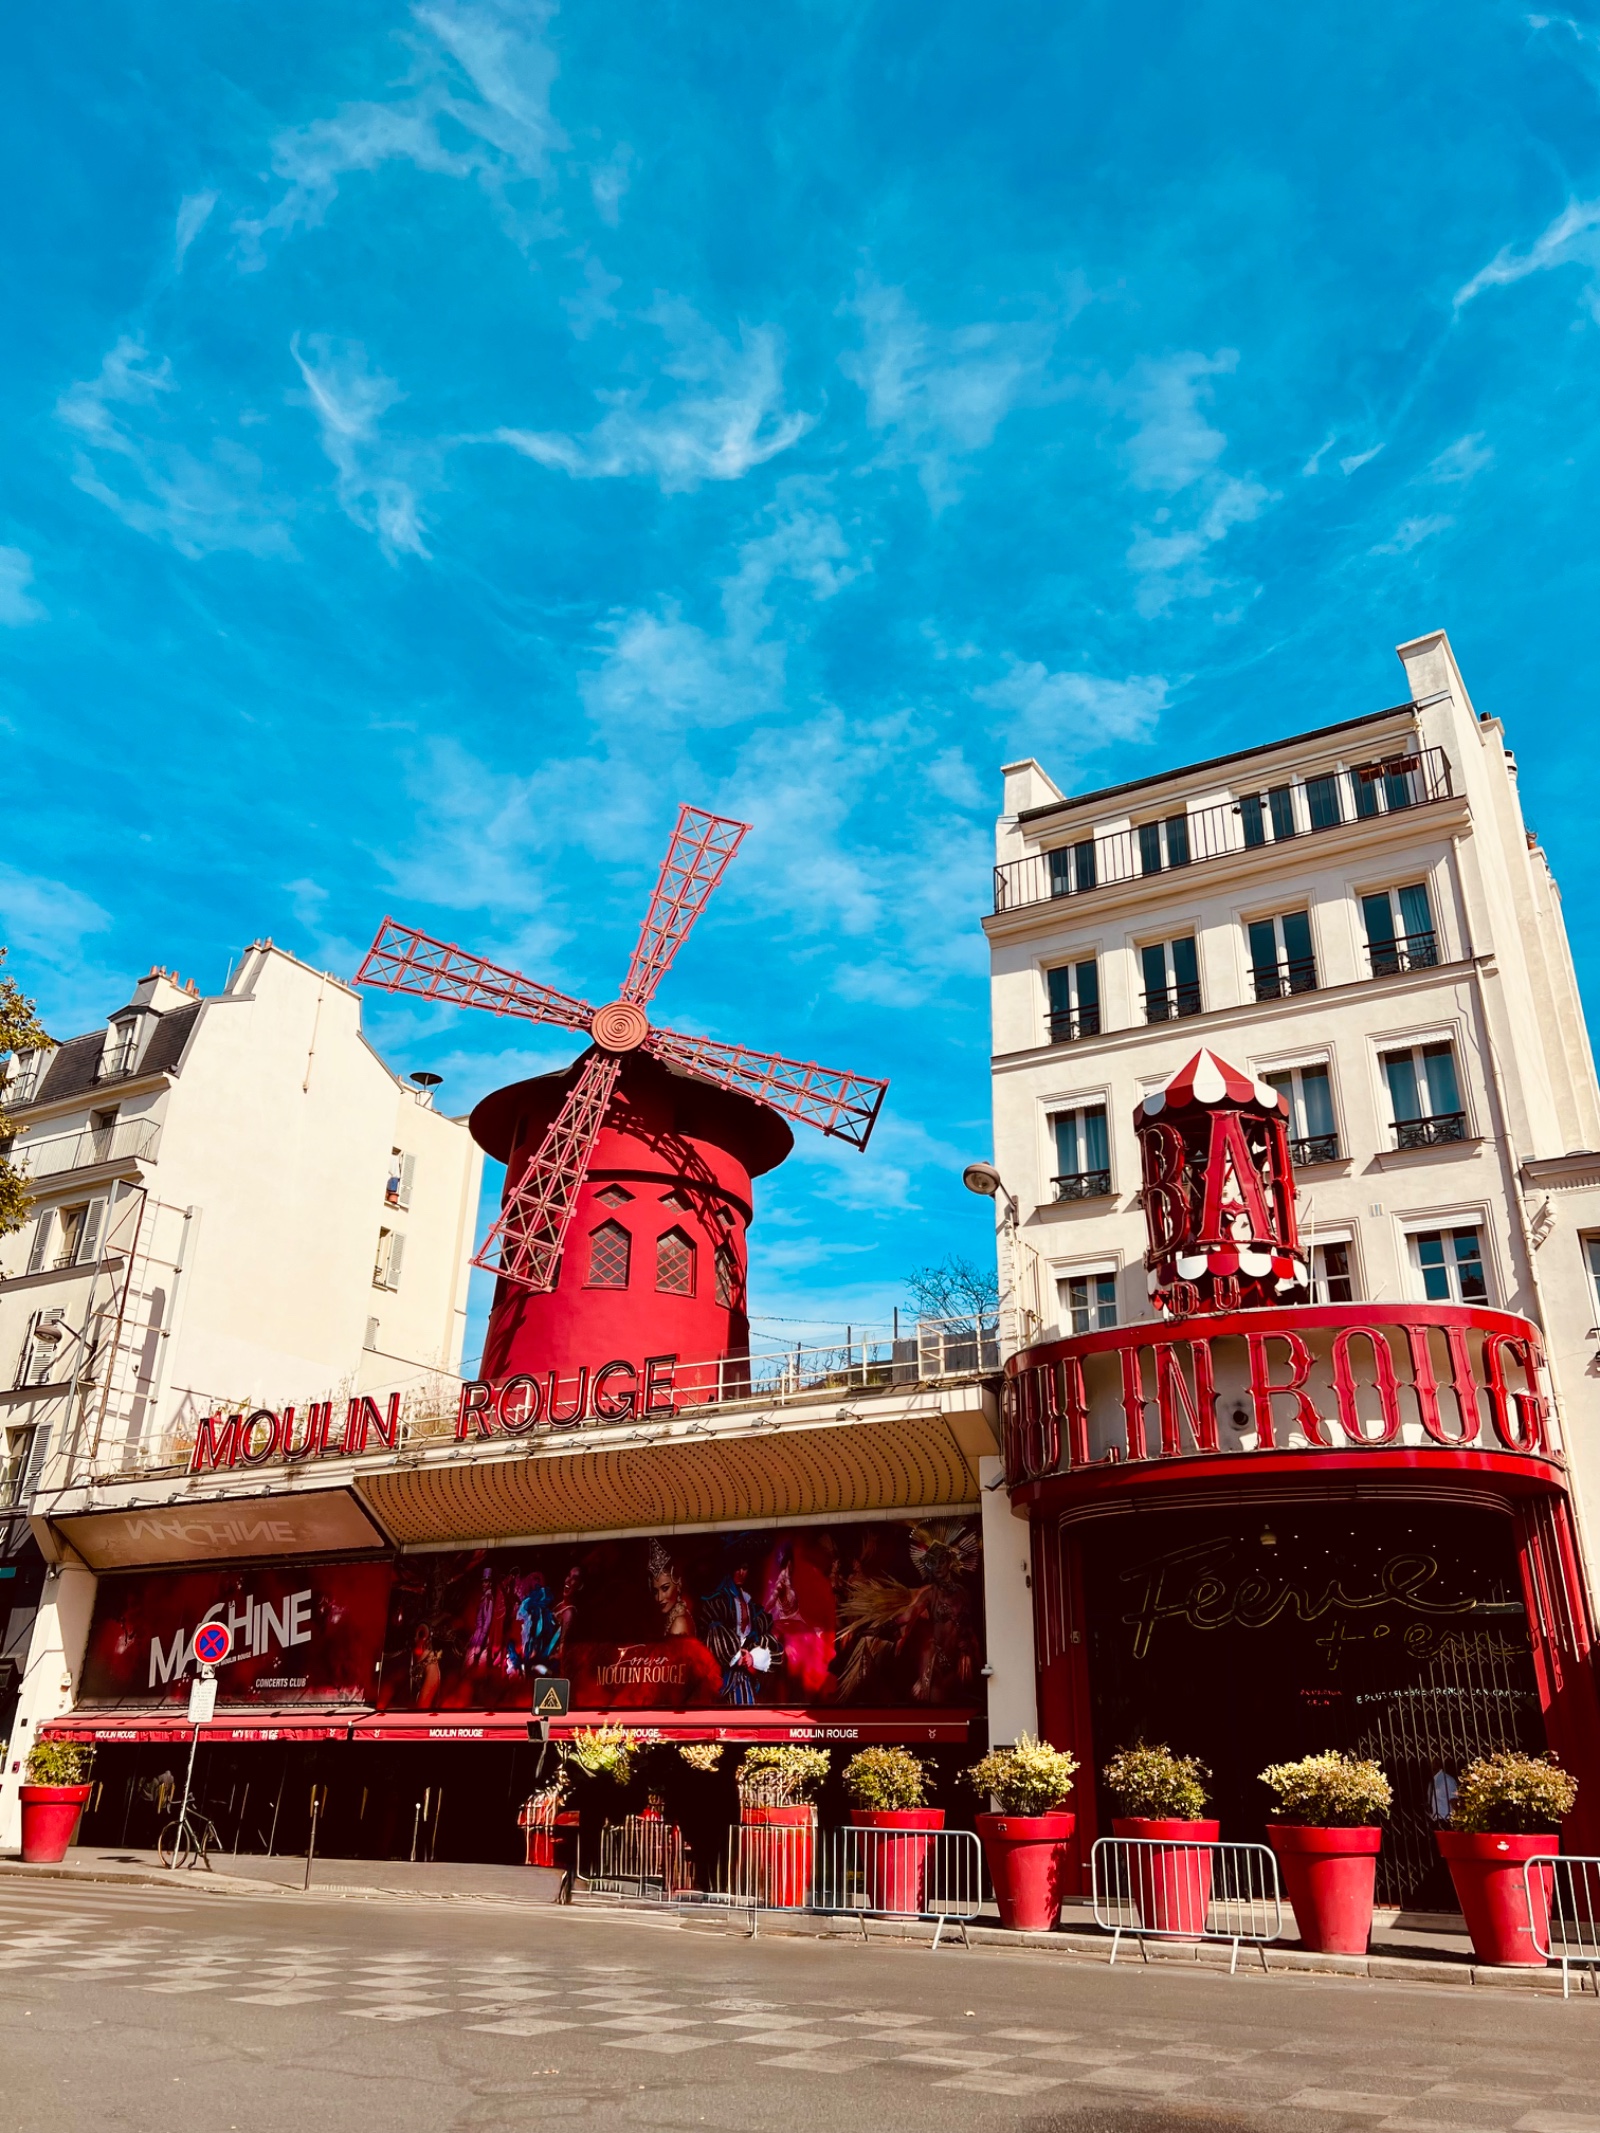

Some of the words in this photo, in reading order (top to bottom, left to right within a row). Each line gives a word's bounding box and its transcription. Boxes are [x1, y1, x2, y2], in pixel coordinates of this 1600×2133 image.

[1171, 1276, 1241, 1316] DU
[191, 1392, 400, 1470] MOULIN
[455, 1353, 680, 1441] ROUGE
[1001, 1338, 1221, 1483] OULIN
[610, 1644, 669, 1668] Forever
[255, 1678, 288, 1688] CONCERTS
[289, 1677, 306, 1688] CLUB
[597, 1665, 641, 1686] MOULIN
[642, 1664, 686, 1684] ROUGE
[95, 1731, 117, 1739] MOULIN
[117, 1731, 137, 1739] ROUGE
[429, 1729, 457, 1738] MOULIN
[458, 1729, 483, 1738] ROUGE
[789, 1729, 825, 1738] MOULIN
[826, 1729, 859, 1738] ROUGE
